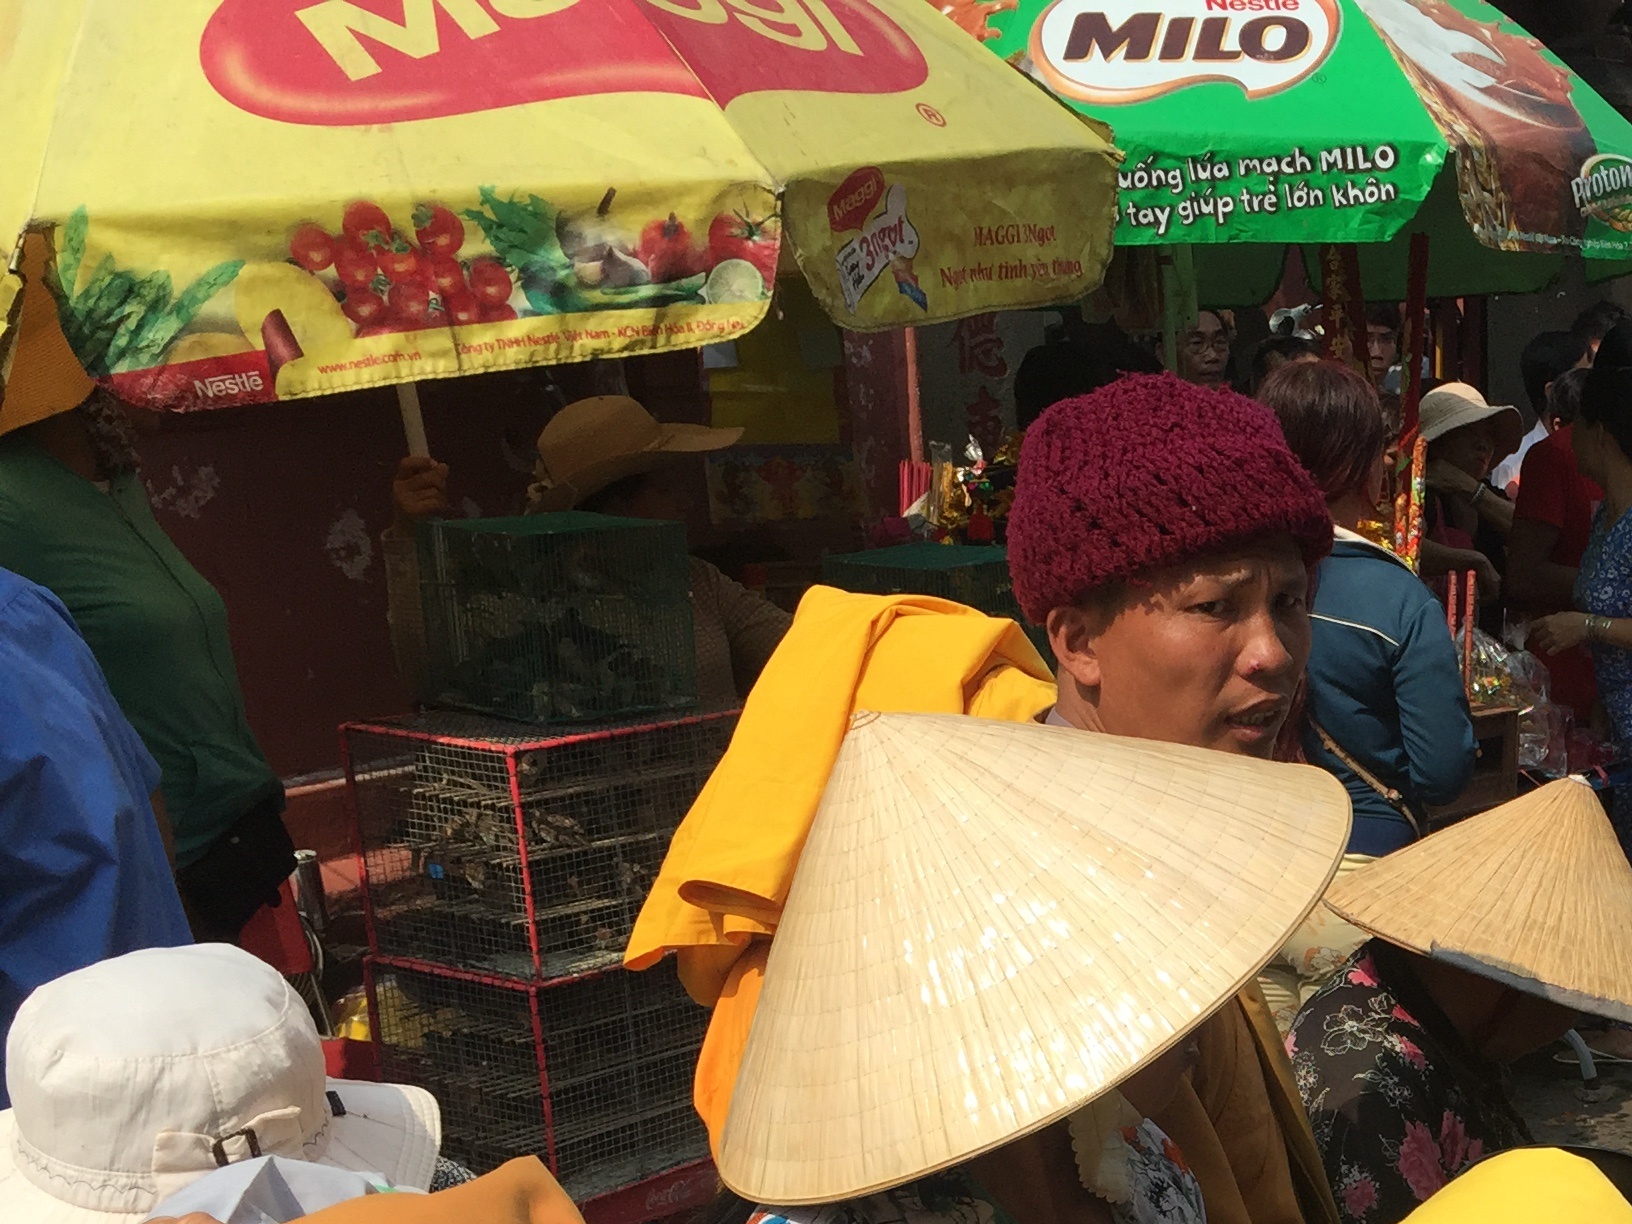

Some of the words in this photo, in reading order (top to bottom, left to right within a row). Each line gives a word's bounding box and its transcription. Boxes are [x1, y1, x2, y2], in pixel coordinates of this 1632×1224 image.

[1062, 11, 1313, 64] MILO
[1118, 155, 1183, 193] uống
[1187, 153, 1230, 182] lúa
[1238, 147, 1312, 183] mạch
[1320, 145, 1395, 173] MILO
[832, 175, 878, 222] Maggi
[1126, 202, 1170, 234] tay
[1177, 188, 1234, 224] giúp
[1284, 181, 1324, 209] lớn
[1331, 177, 1396, 208] khôn
[317, 350, 422, 375] www.nestle.com.vn
